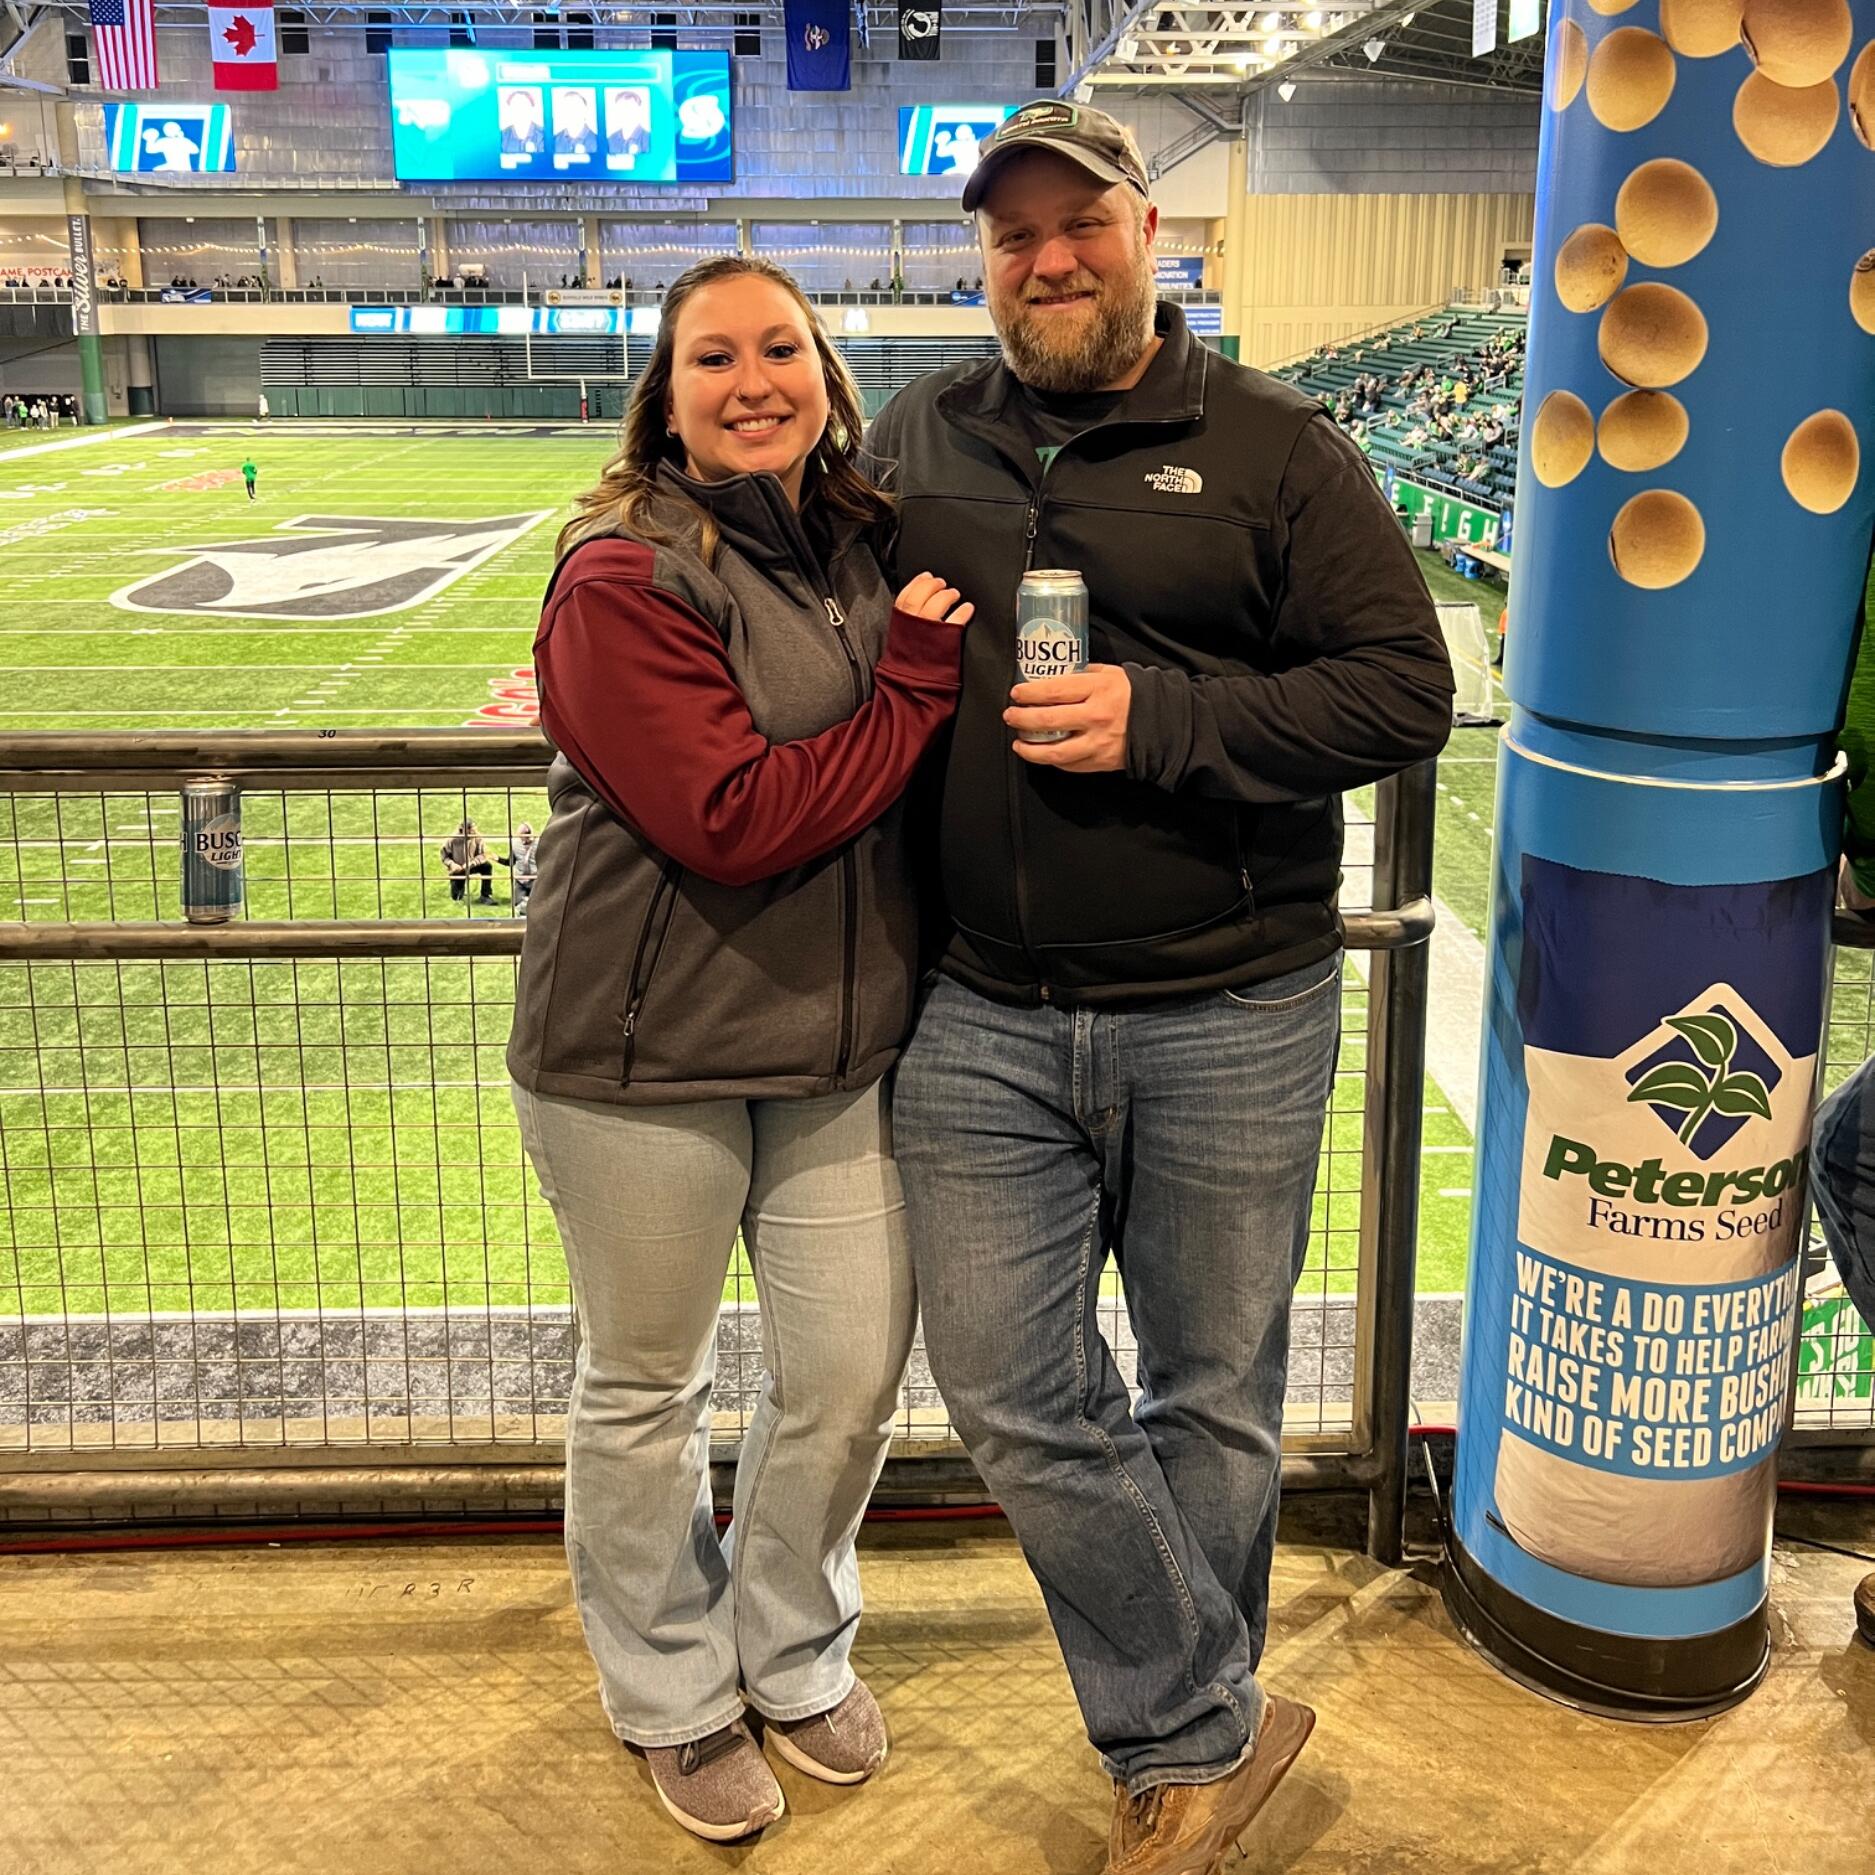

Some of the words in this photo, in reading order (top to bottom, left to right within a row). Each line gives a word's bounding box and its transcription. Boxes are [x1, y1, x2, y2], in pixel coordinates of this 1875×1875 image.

[1163, 465, 1186, 476] THE
[1144, 473, 1184, 484] NORTH
[1152, 482, 1182, 493] FACE
[1024, 663, 1068, 675] LIGHT
[318, 729, 336, 738] 30
[211, 850, 240, 861] LIGH
[1586, 1197, 1705, 1242] Farms
[1715, 1198, 1782, 1241] Seed
[1612, 1288, 1631, 1329] A
[1643, 1291, 1685, 1335] DO
[1511, 1293, 1534, 1335] IT
[1540, 1306, 1625, 1368] TAKES
[1633, 1335, 1668, 1375] TO
[1676, 1335, 1743, 1375] HELP
[1508, 1332, 1600, 1411] RAISE
[1611, 1372, 1712, 1425] MORE
[1505, 1380, 1574, 1447] KIND
[1582, 1414, 1624, 1461] OF
[1632, 1425, 1712, 1469] SEED
